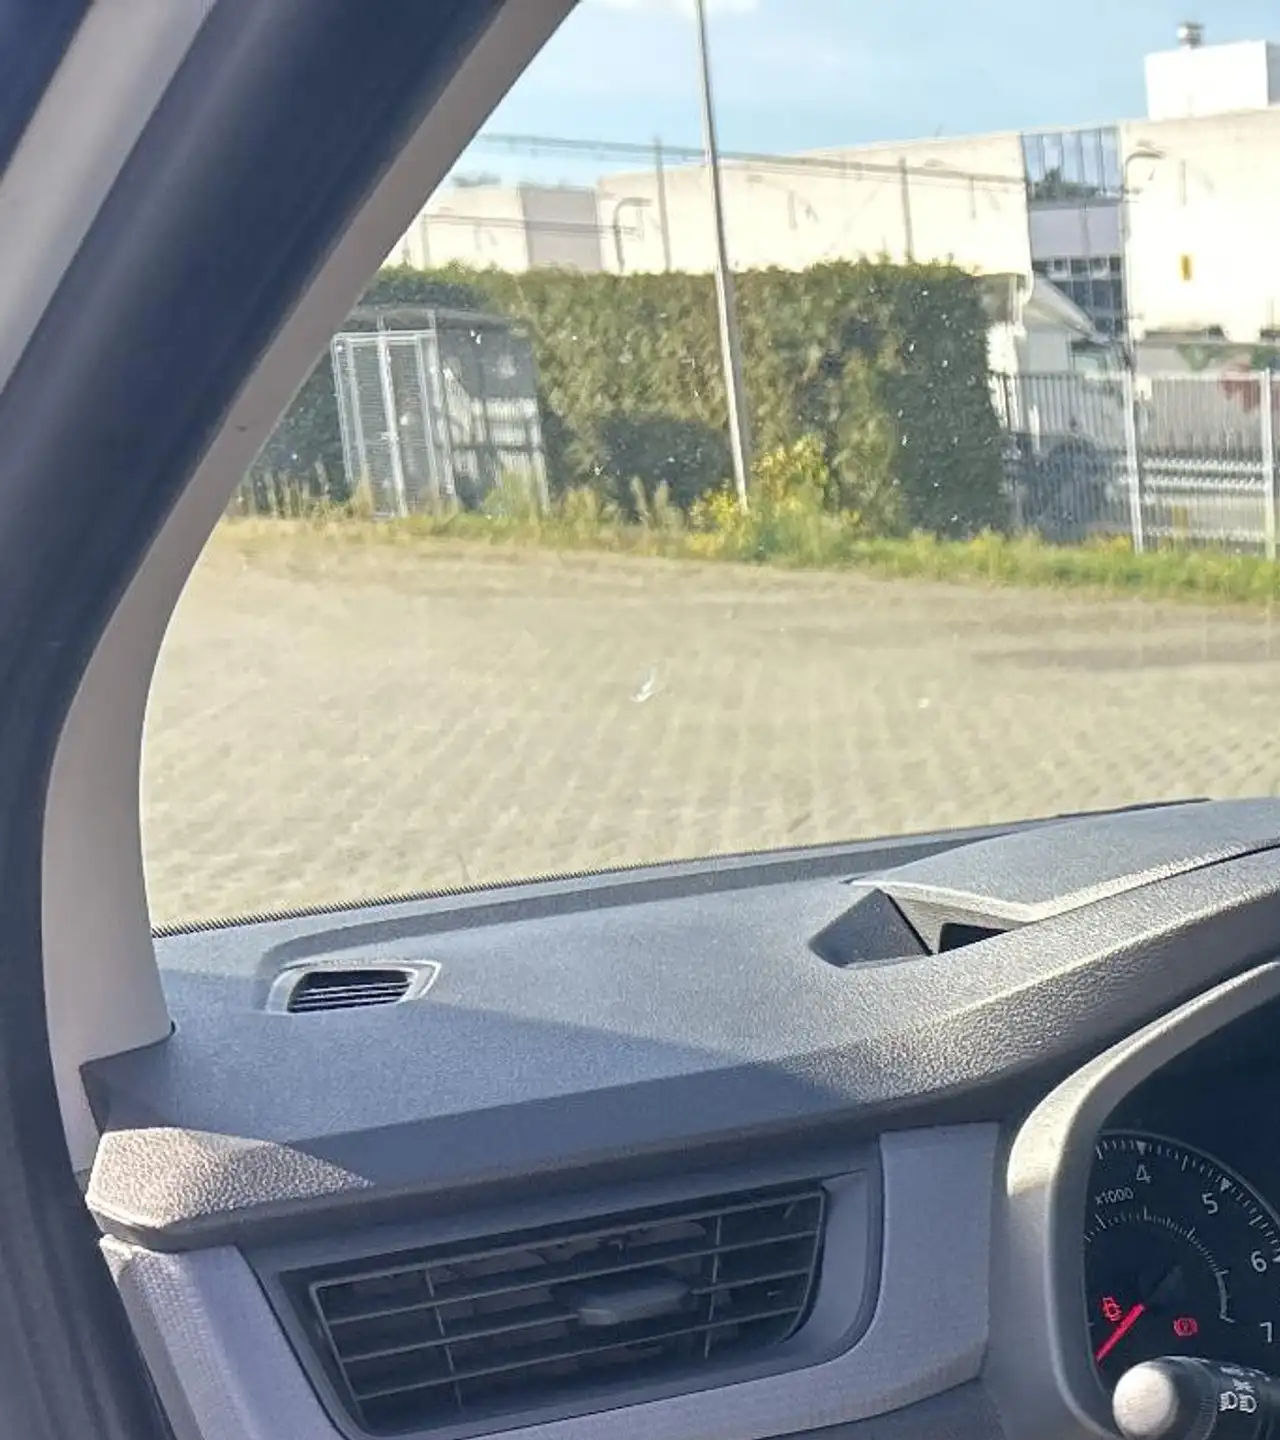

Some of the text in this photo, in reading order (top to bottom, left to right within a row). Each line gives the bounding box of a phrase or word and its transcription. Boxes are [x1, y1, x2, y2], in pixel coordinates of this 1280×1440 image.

[1136, 1164, 1151, 1184] 4
[1201, 1192, 1219, 1215] 5
[1251, 1250, 1268, 1273] 6
[1259, 1321, 1274, 1343] 7
